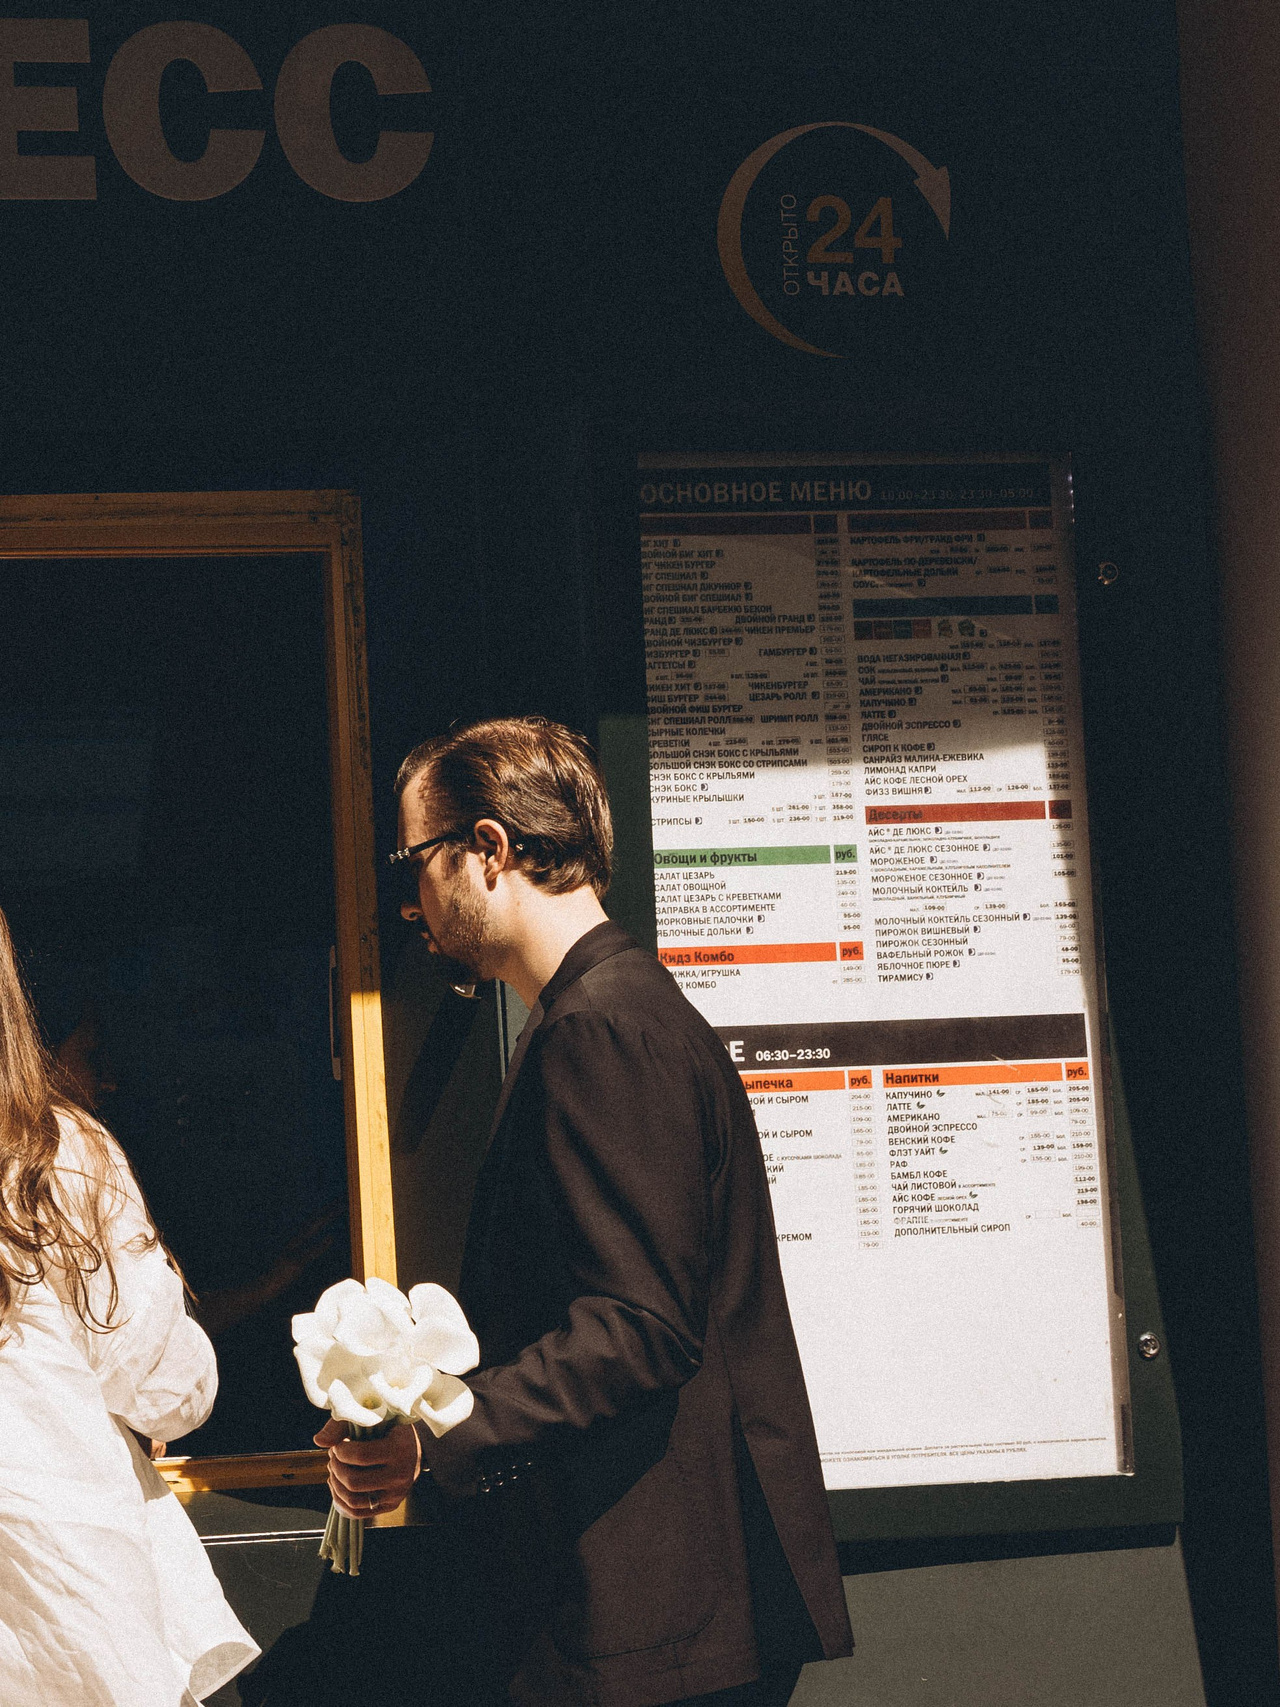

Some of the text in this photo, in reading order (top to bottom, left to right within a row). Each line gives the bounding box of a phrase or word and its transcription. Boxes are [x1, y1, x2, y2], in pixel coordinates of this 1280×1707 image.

[806, 194, 902, 264] 24
[780, 193, 800, 297] ОТКРЫТО
[807, 271, 905, 297] ЧАСА
[641, 481, 783, 505] ОСНОВНОЕ
[791, 480, 872, 501] МЕНЮ
[759, 647, 807, 656] ГАМБУРГЕР
[858, 653, 962, 664] ВОДА НЕГАЗИРОВАННАЯ
[749, 681, 808, 690] ЧИКЕНБУРГЕР
[863, 743, 925, 753] СИРОП К КОФЕ
[863, 753, 984, 764] САНРАЙЗ МАЛИНА-ЕЖЕВИКА
[674, 771, 755, 781] БОКС КРЫЛЬЯМИ
[864, 766, 936, 775] ЛИМОНАД КАПРИ
[865, 773, 967, 785] АЙС КОФЕ ЛЕСНОЙ ОРЕХ
[674, 784, 697, 792] БОКС
[866, 786, 923, 796] ФИЗЗ ВИШНЯ
[693, 794, 744, 802] КРЫЛЫШКИ
[868, 808, 923, 822] Десерты
[893, 827, 931, 837] ДЕ ЛЮКС
[894, 844, 979, 855] ДЕ ЛЮКС СЕЗОННОЕ
[655, 849, 856, 866] Овощи и фрукты руб.
[870, 857, 925, 866] МОРОЖЕНОЕ
[655, 871, 714, 880] САЛАТ ЦЕЗАРЬ
[872, 872, 973, 883] МОРОЖЕНОЕ СЕЗОННОЕ
[655, 880, 726, 892] САЛАТ ОВОЩНОЙ
[872, 883, 968, 895] МОЛОЧНЫЙ КОКТЕЙЛЬ
[656, 892, 781, 903] САЛАТ ЦЕЗАРЬ КРЕВЕТКАМИ
[656, 904, 775, 914] ЗАПРАВКА В АССОРТИМЕНТЕ
[657, 915, 754, 926] МОРКОВНЫЕ ПАЛОЧКИ
[875, 913, 1020, 926] МОЛОЧНЫЙ КОКТЕЙЛЬ СЕЗОННЫЙ
[657, 928, 742, 937] ЯБЛОЧНЫЕ ДОЛЬКИ
[875, 925, 969, 937] ПИРОЖОК ВИШНЕВЫЙ
[876, 937, 968, 948] ПИРОЖОК СЕЗОННЫЙ
[660, 946, 863, 965] Кидз Комбо руб.
[877, 949, 964, 959] ВАФЕЛЬНЫЙ РОЖОК
[877, 960, 950, 971] ЯБЛОЧНОЕ ПЮРЕ
[878, 973, 923, 983] ТИРАМИСУ
[686, 981, 716, 989] КОМБО
[755, 1048, 831, 1062] 06:30–23:30
[886, 1067, 1087, 1085] Напитки руб.
[745, 1076, 871, 1090] ыпечка руб.
[776, 1095, 809, 1104] СЫРОМ
[886, 1090, 932, 1101] КАПУЧИНО
[886, 1102, 912, 1111] ЛАТТЕ
[887, 1113, 940, 1123] АМЕРИКАНО
[780, 1129, 813, 1138] СЫРОМ
[888, 1122, 978, 1135] ДВОЙНОЙ ЭСПРЕССО
[889, 1135, 956, 1146] ВЕНСКИЙ КОФЕ
[889, 1146, 935, 1157] ФЛЭТ УАЙТ
[890, 1160, 908, 1169] РАФ
[891, 1170, 948, 1180] БАМБЛ КОФЕ
[891, 1179, 956, 1191] ЧАЙ ЛИСТОВОЙ
[892, 1193, 935, 1203] АЙС КОФЕ
[893, 1203, 979, 1214] ГОРЯЧИЙ ШОКОЛАД
[894, 1223, 1011, 1238] ДОПОЛНИТЕЛЬНЫЙ СИРОП
